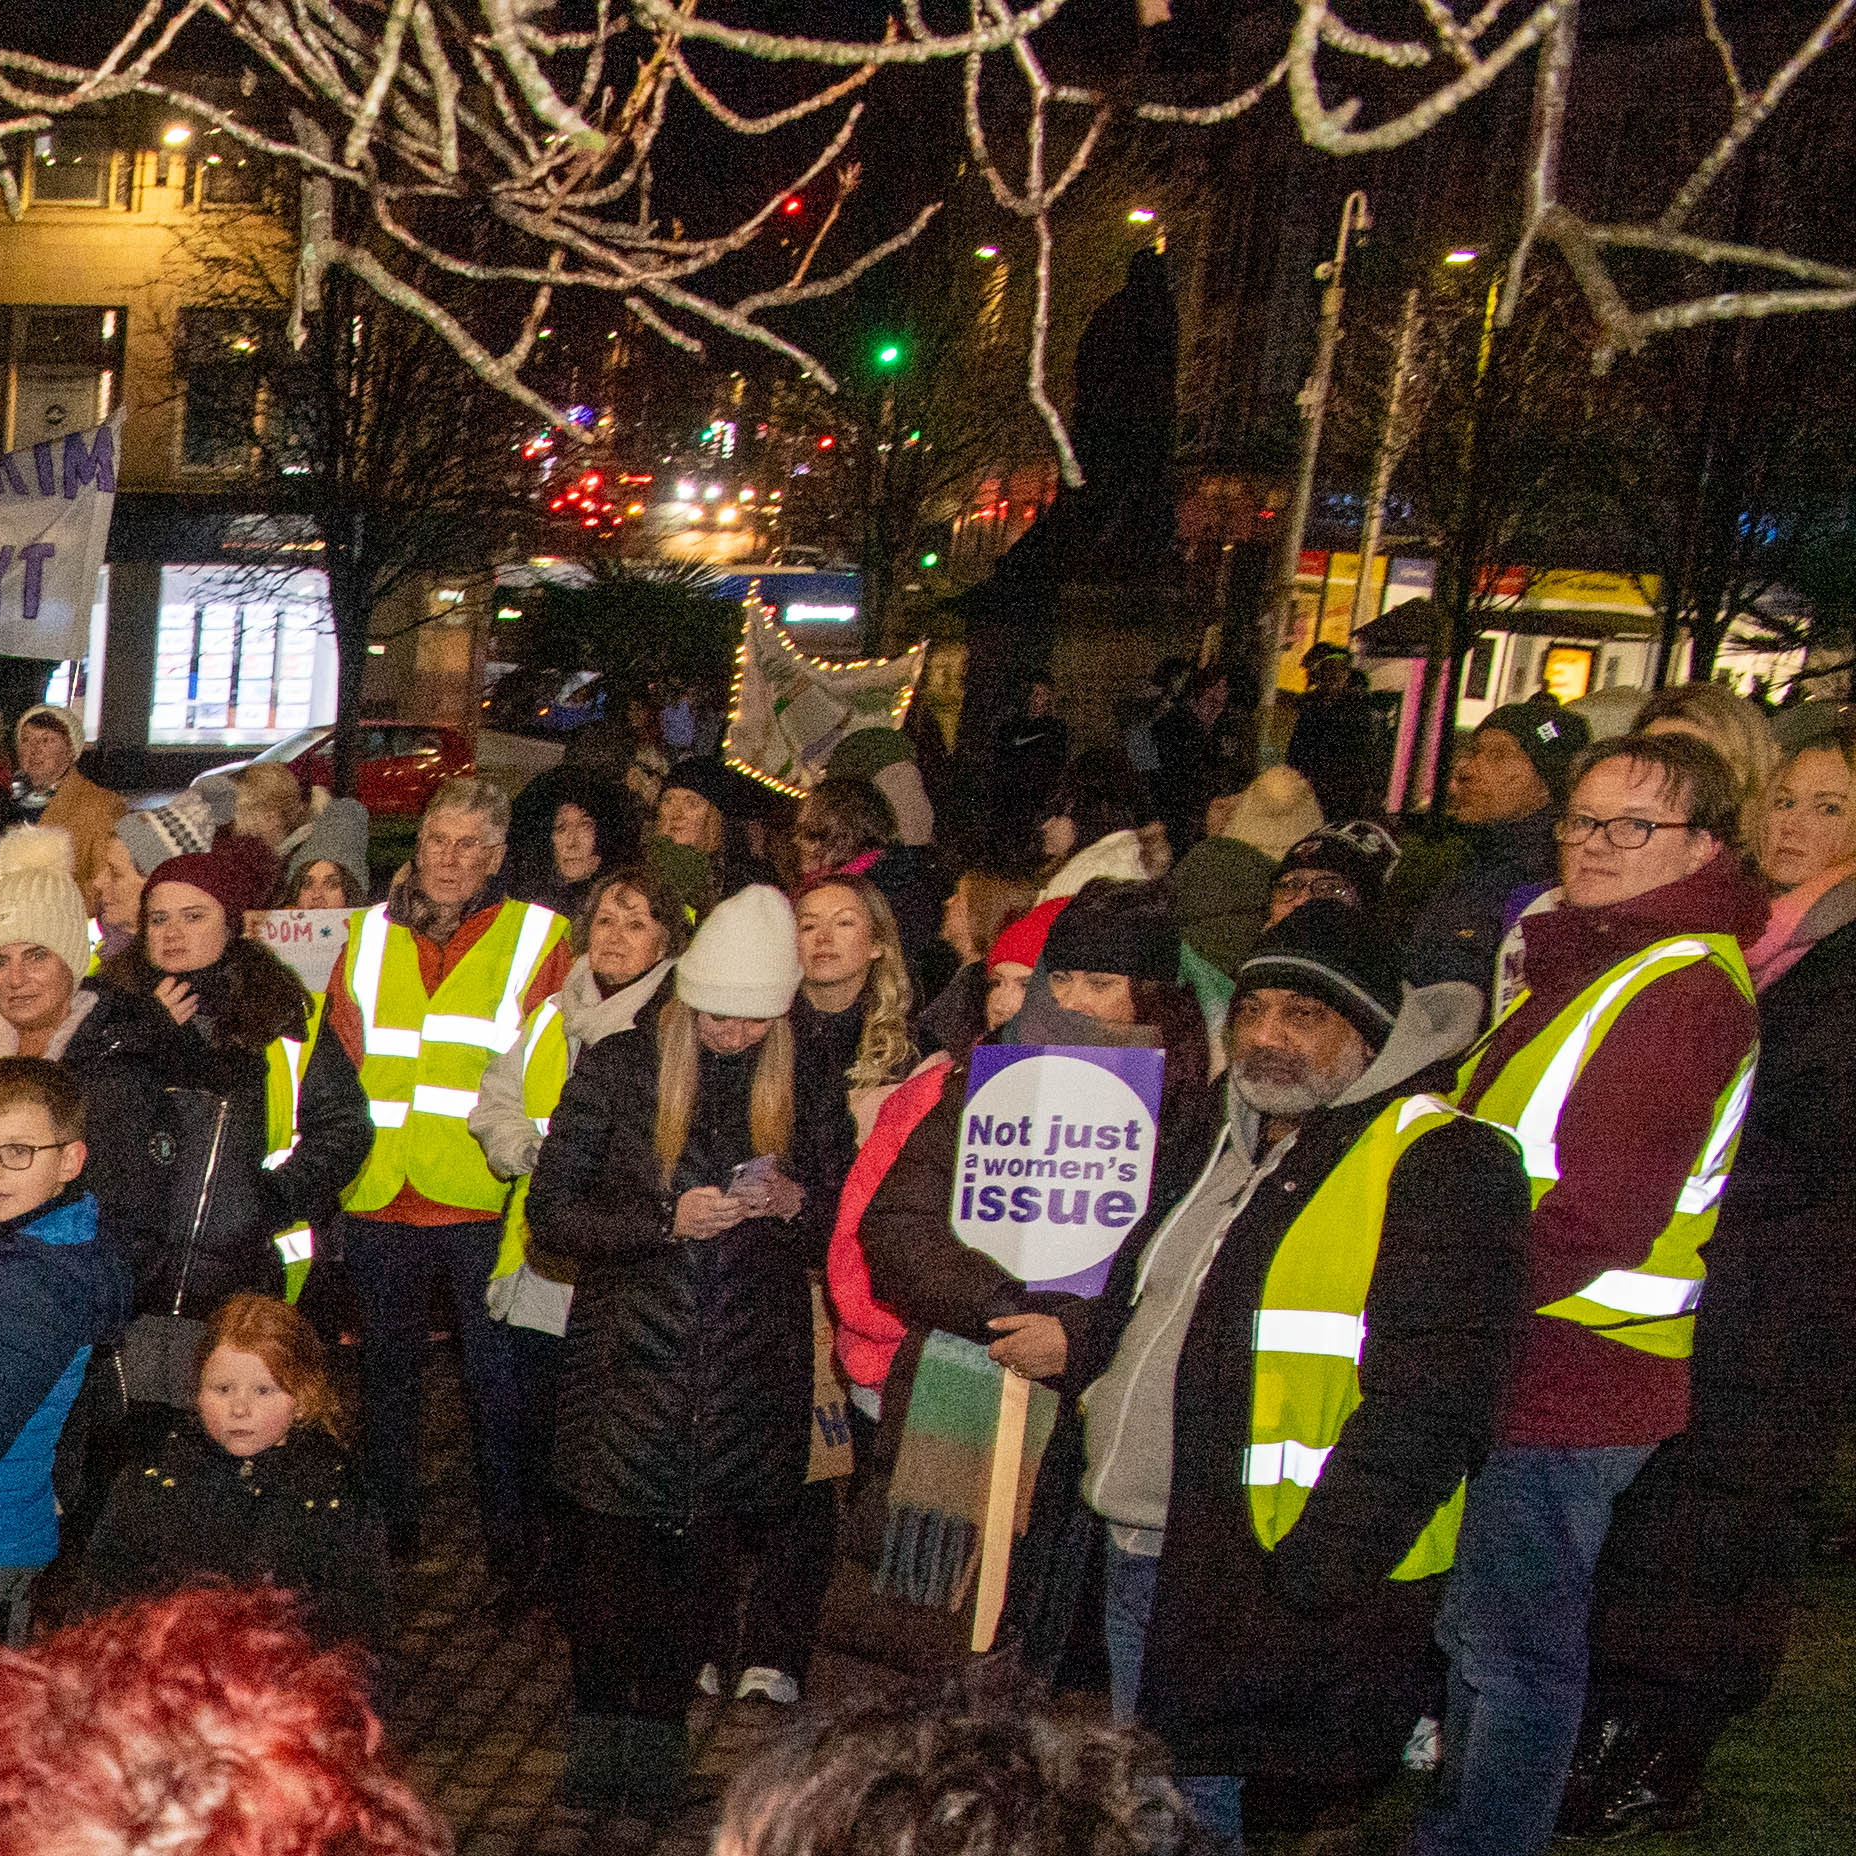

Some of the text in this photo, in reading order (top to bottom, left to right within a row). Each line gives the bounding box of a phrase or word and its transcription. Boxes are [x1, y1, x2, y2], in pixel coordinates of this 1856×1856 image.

[967, 1114, 1142, 1156] Not just
[964, 1153, 1138, 1182] a women's
[960, 1172, 1137, 1229] issue
